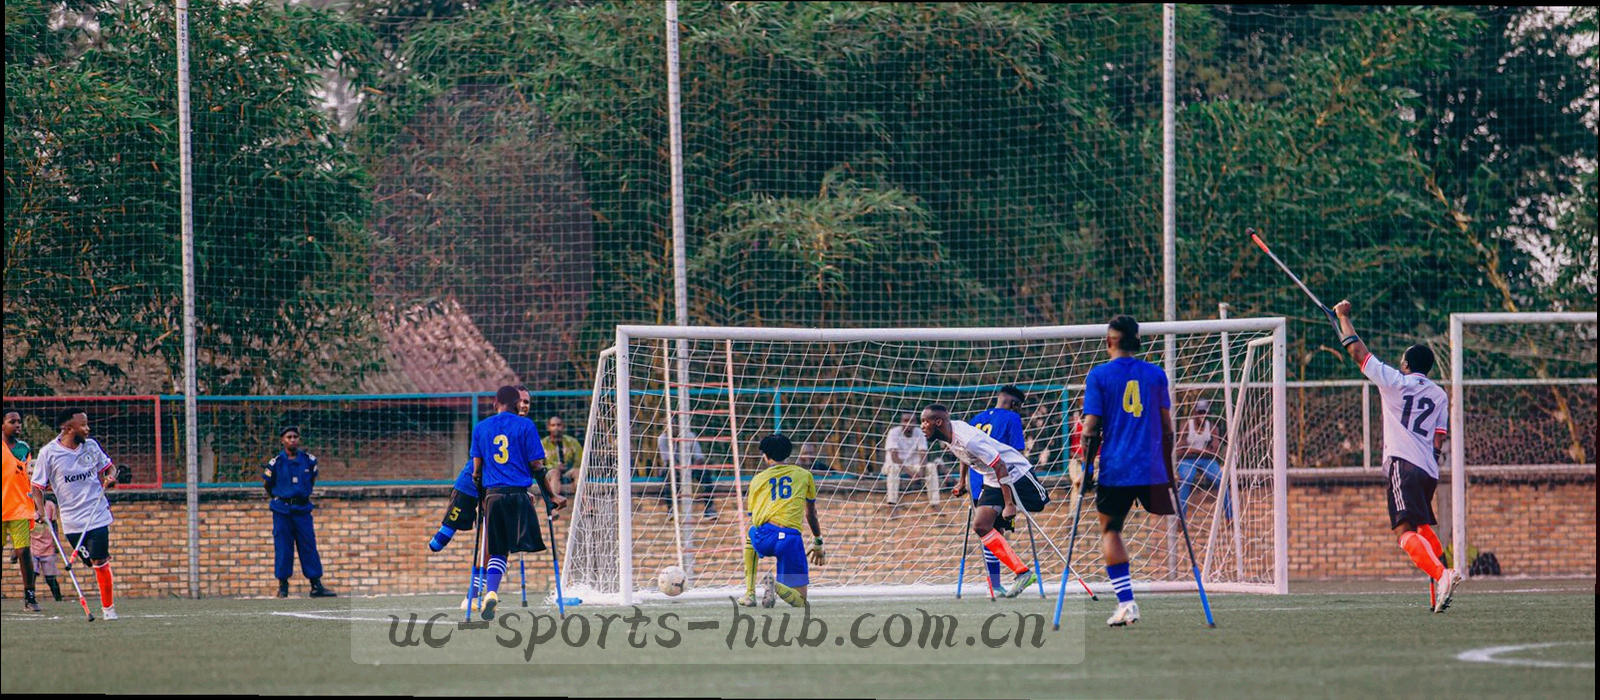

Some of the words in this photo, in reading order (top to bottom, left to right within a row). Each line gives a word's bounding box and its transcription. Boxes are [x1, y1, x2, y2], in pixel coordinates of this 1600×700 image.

[1122, 379, 1144, 418] 4
[1400, 395, 1436, 438] 12
[493, 434, 509, 465] 3
[64, 470, 92, 484] Kenya
[768, 475, 793, 501] 16
[449, 506, 462, 522] 5
[79, 545, 90, 559] 8
